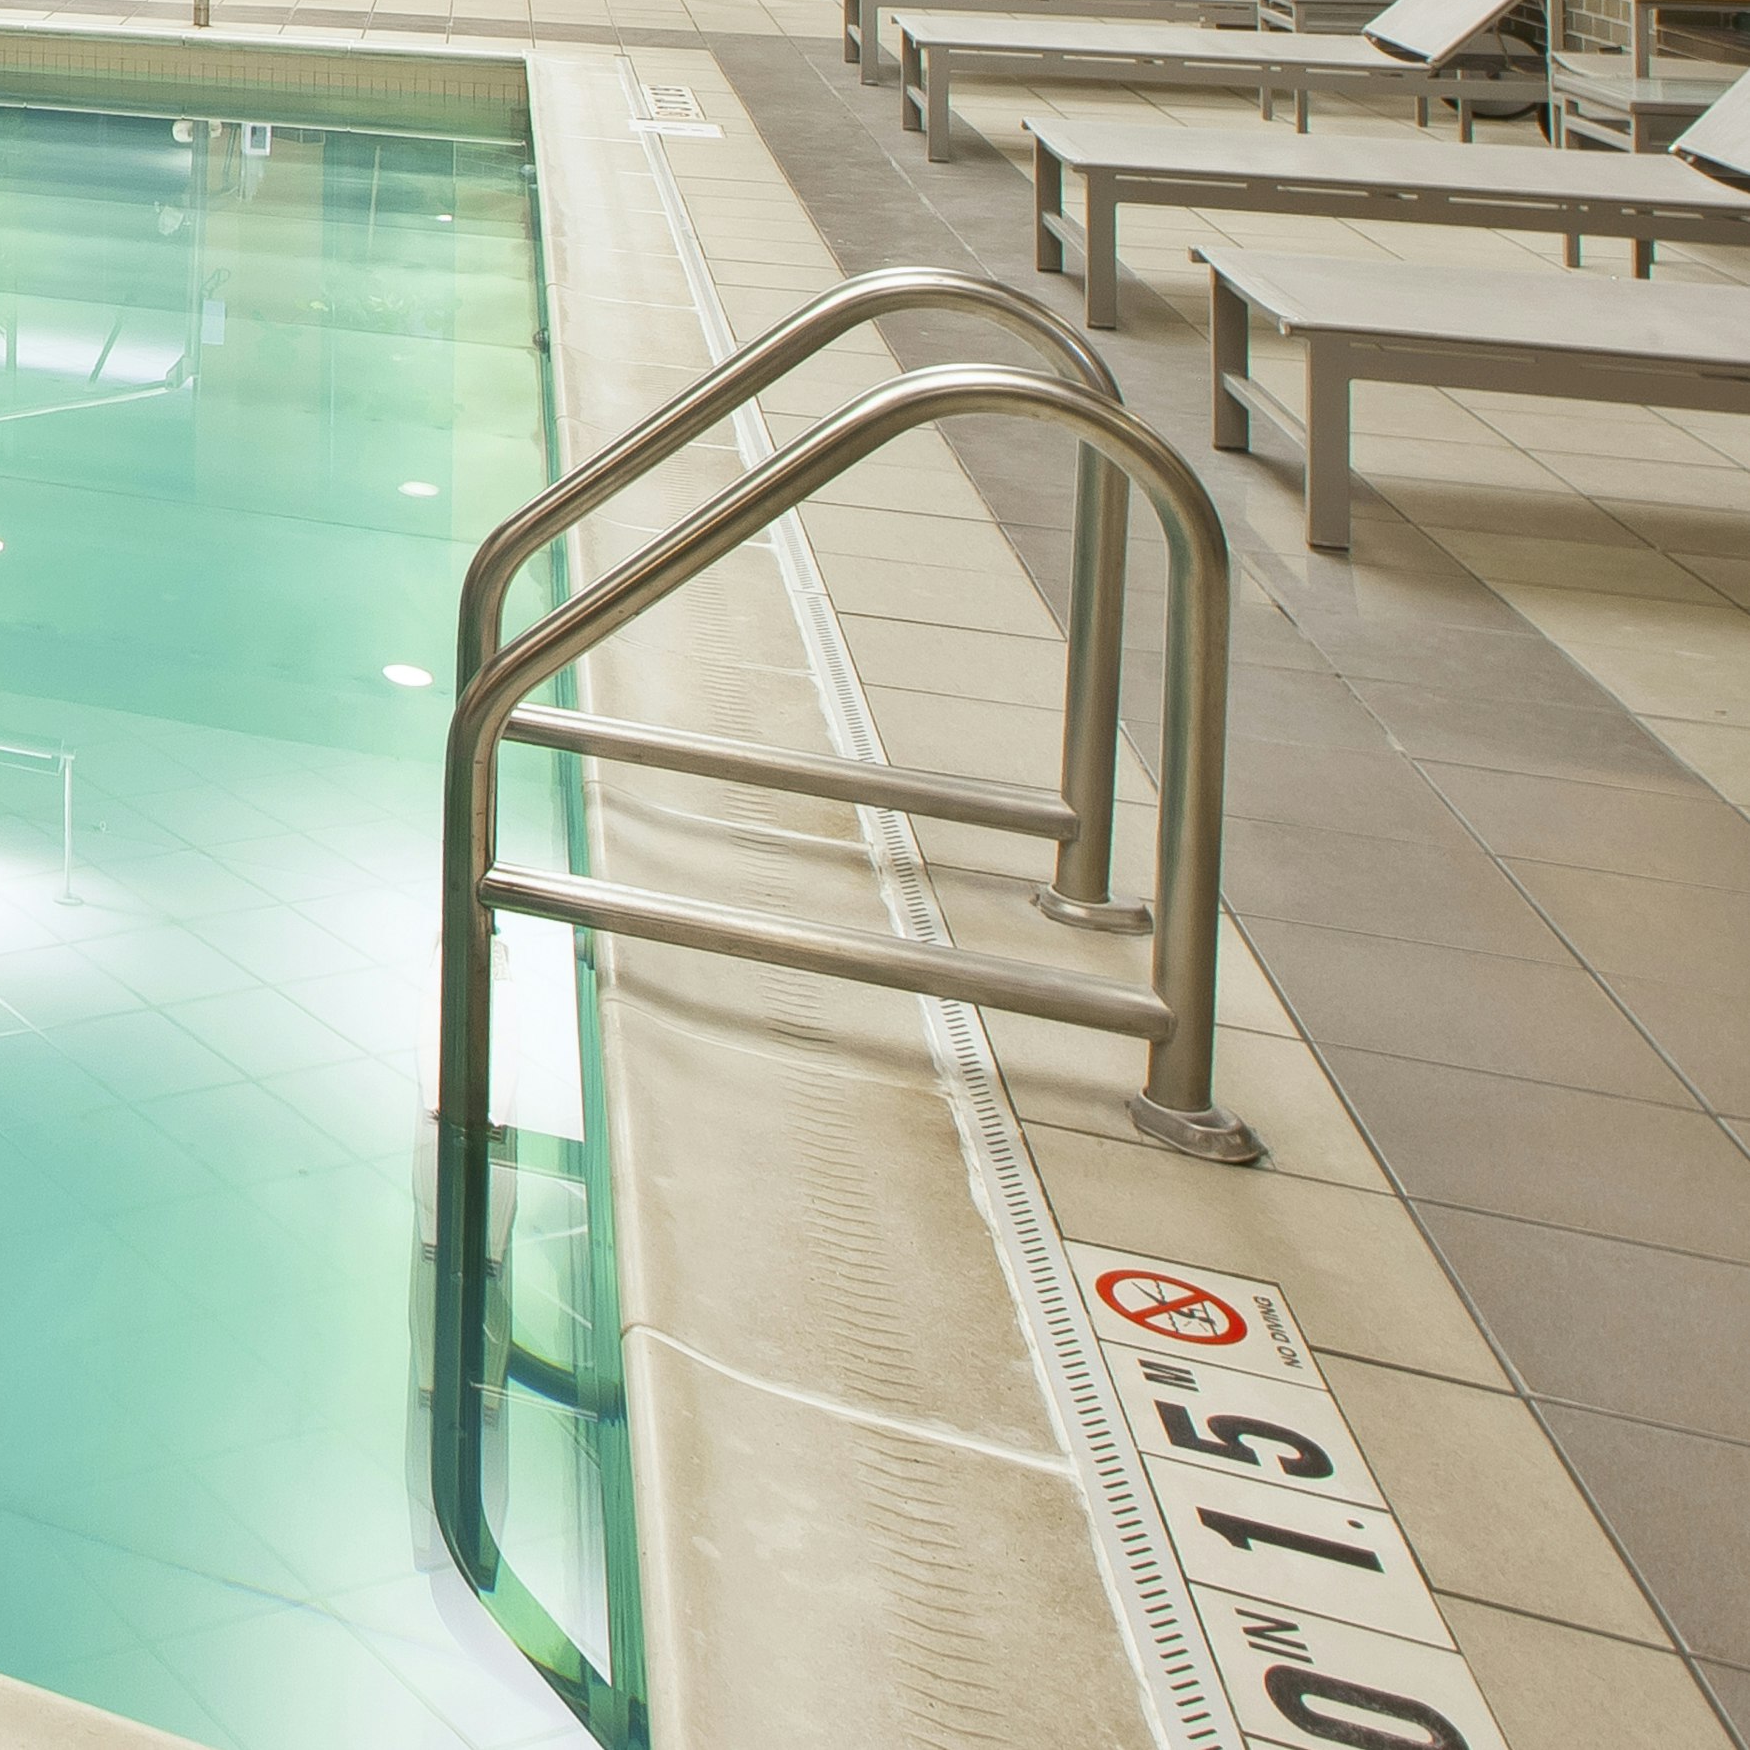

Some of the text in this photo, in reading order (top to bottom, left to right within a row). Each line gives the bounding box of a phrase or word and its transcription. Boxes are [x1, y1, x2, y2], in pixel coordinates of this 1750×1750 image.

[1252, 1295, 1304, 1370] NO DIVING
[1136, 1357, 1200, 1393] M
[1234, 1606, 1315, 1665] IN
